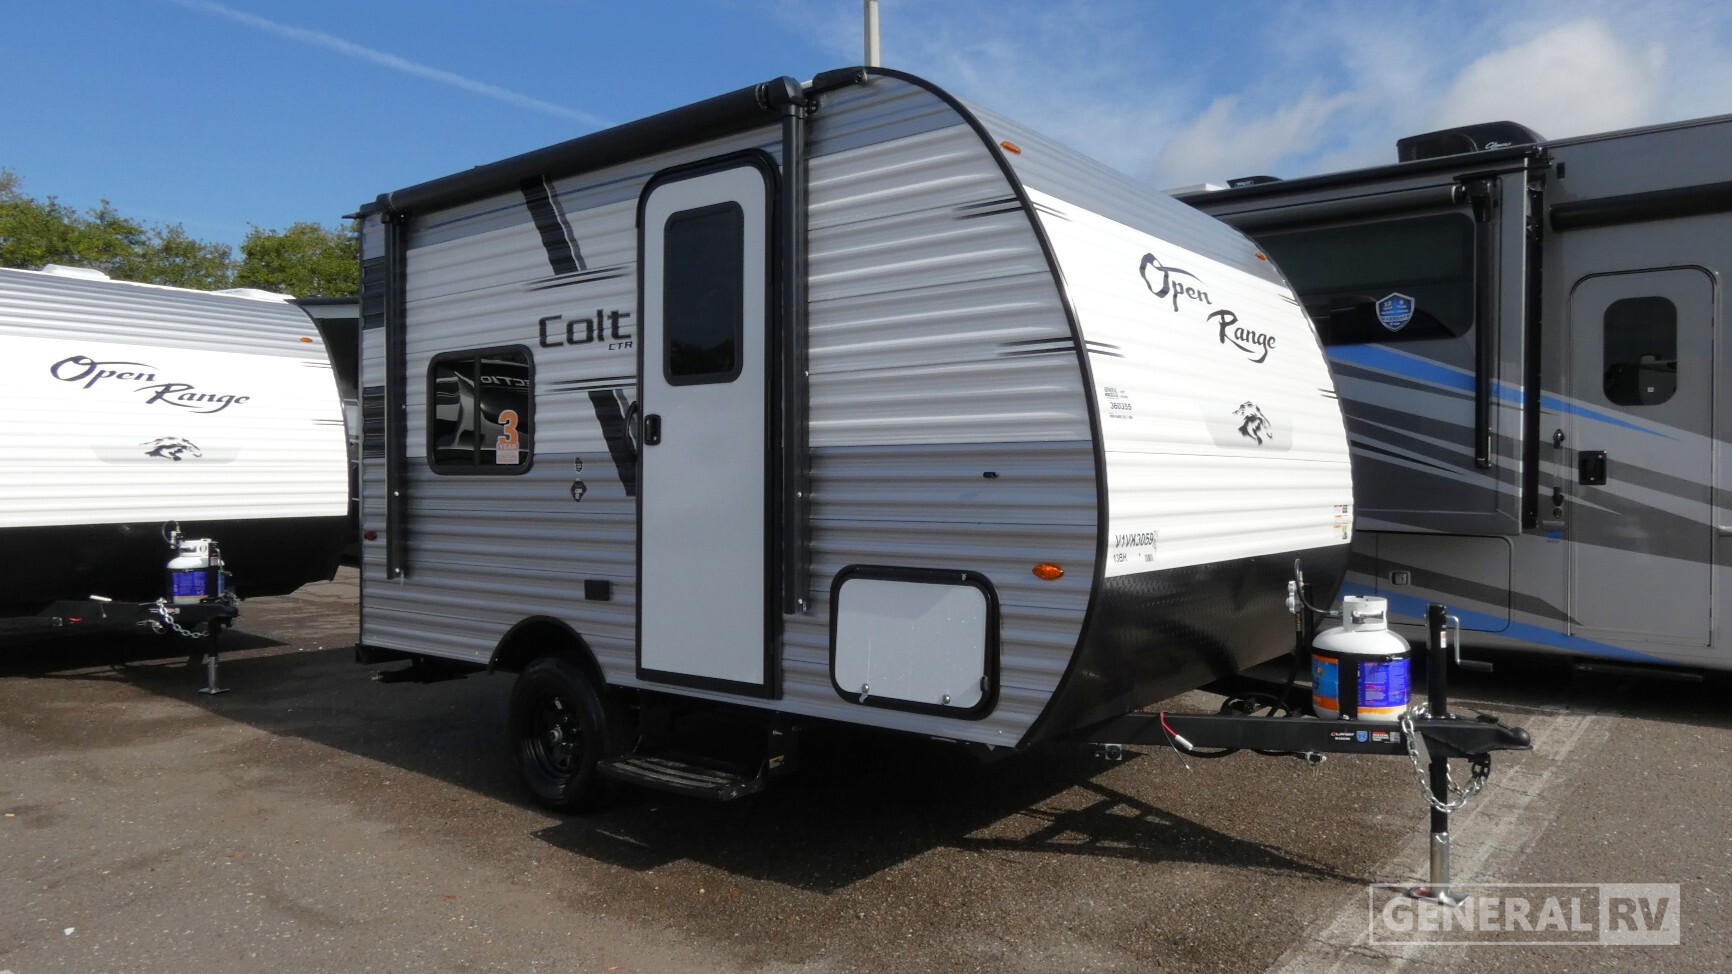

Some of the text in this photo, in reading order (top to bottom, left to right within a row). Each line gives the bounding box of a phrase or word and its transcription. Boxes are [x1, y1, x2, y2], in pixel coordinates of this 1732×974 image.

[1139, 253, 1212, 312] Open
[539, 309, 632, 348] Colt
[608, 341, 634, 350] CTR
[1206, 309, 1277, 363] Range
[50, 355, 159, 389] Open
[134, 383, 250, 413] Range
[498, 409, 519, 445] 3
